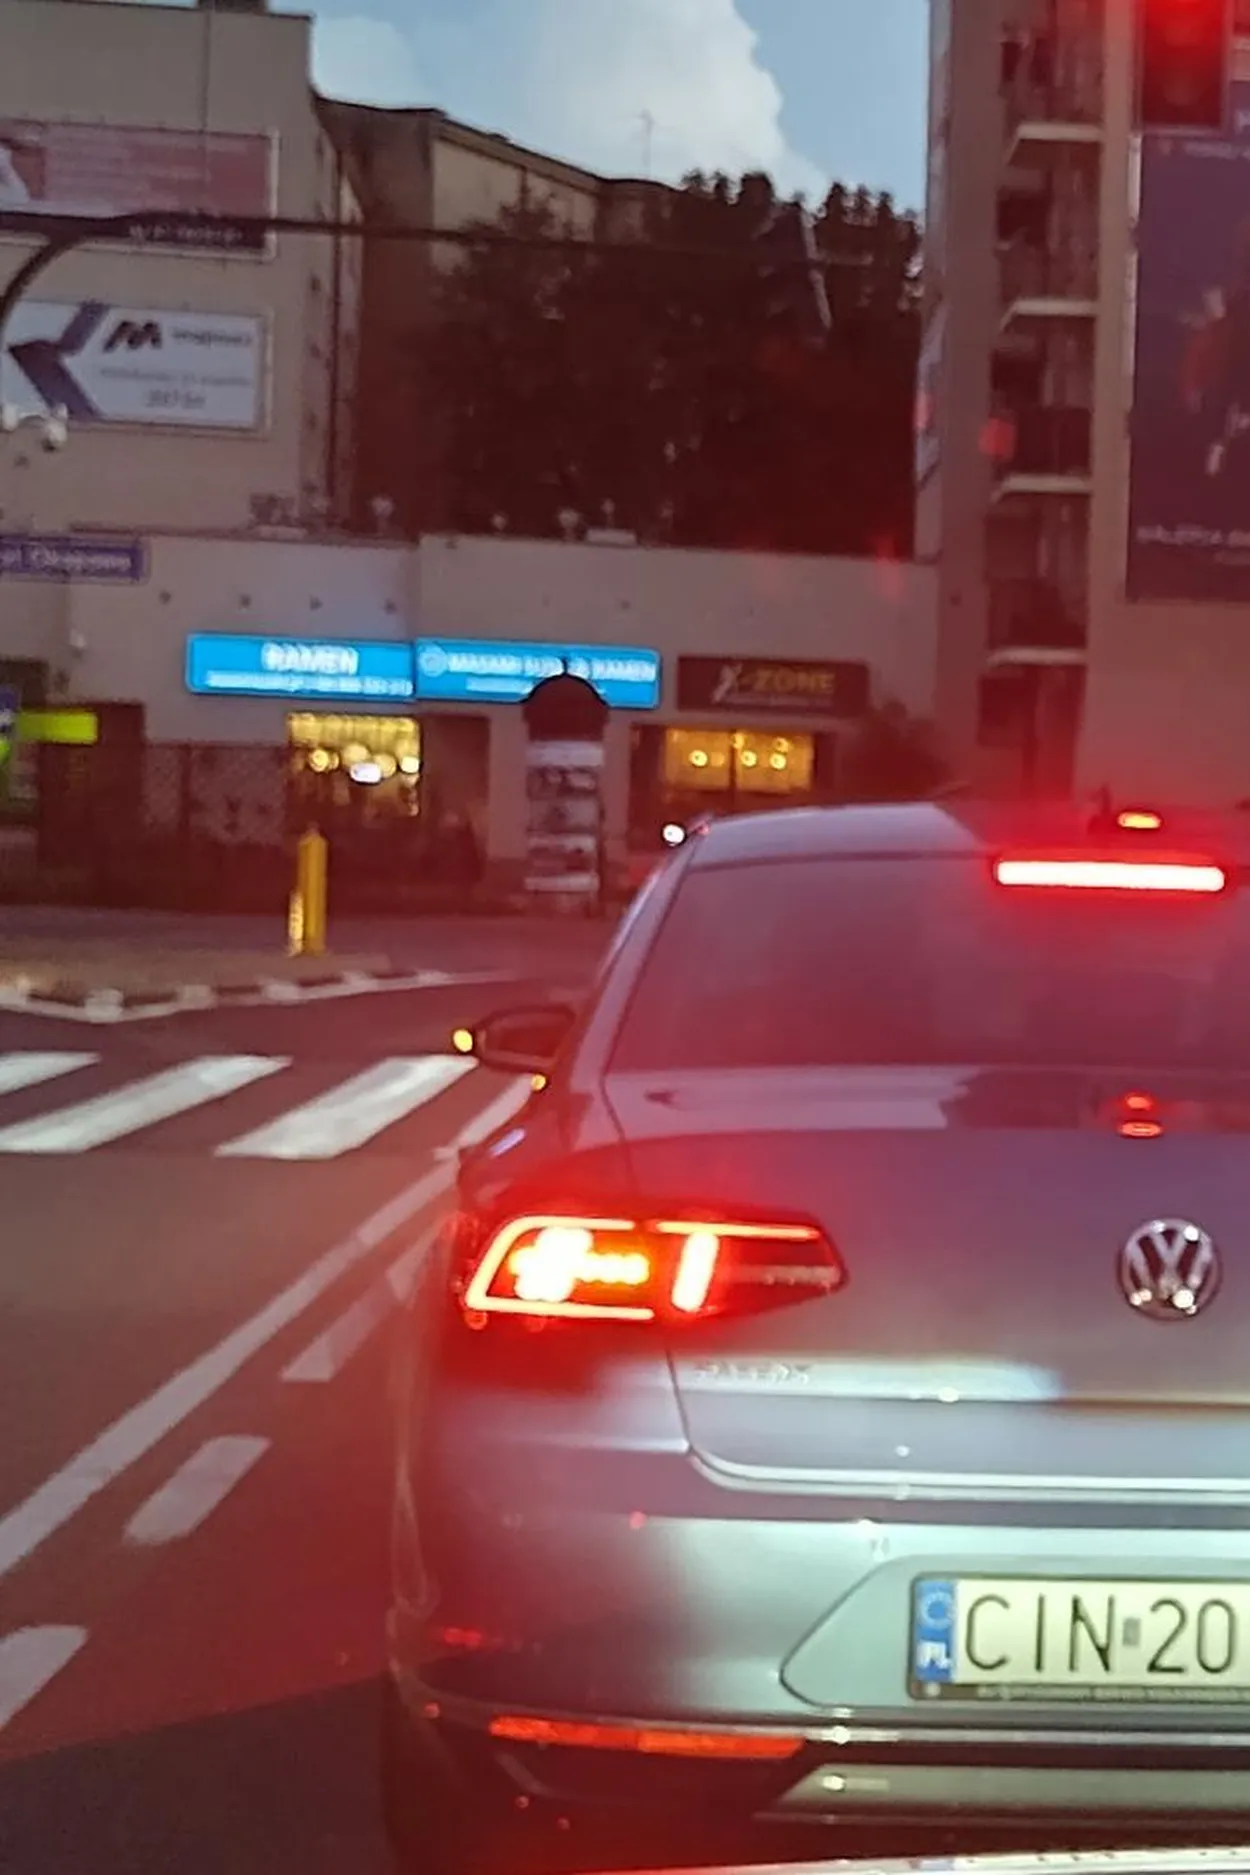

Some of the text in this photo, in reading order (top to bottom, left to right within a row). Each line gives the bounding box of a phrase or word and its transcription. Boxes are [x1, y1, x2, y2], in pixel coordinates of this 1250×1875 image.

[262, 642, 359, 676] RAMEN
[709, 661, 836, 704] X-ZONE
[964, 1593, 1117, 1674] CIN
